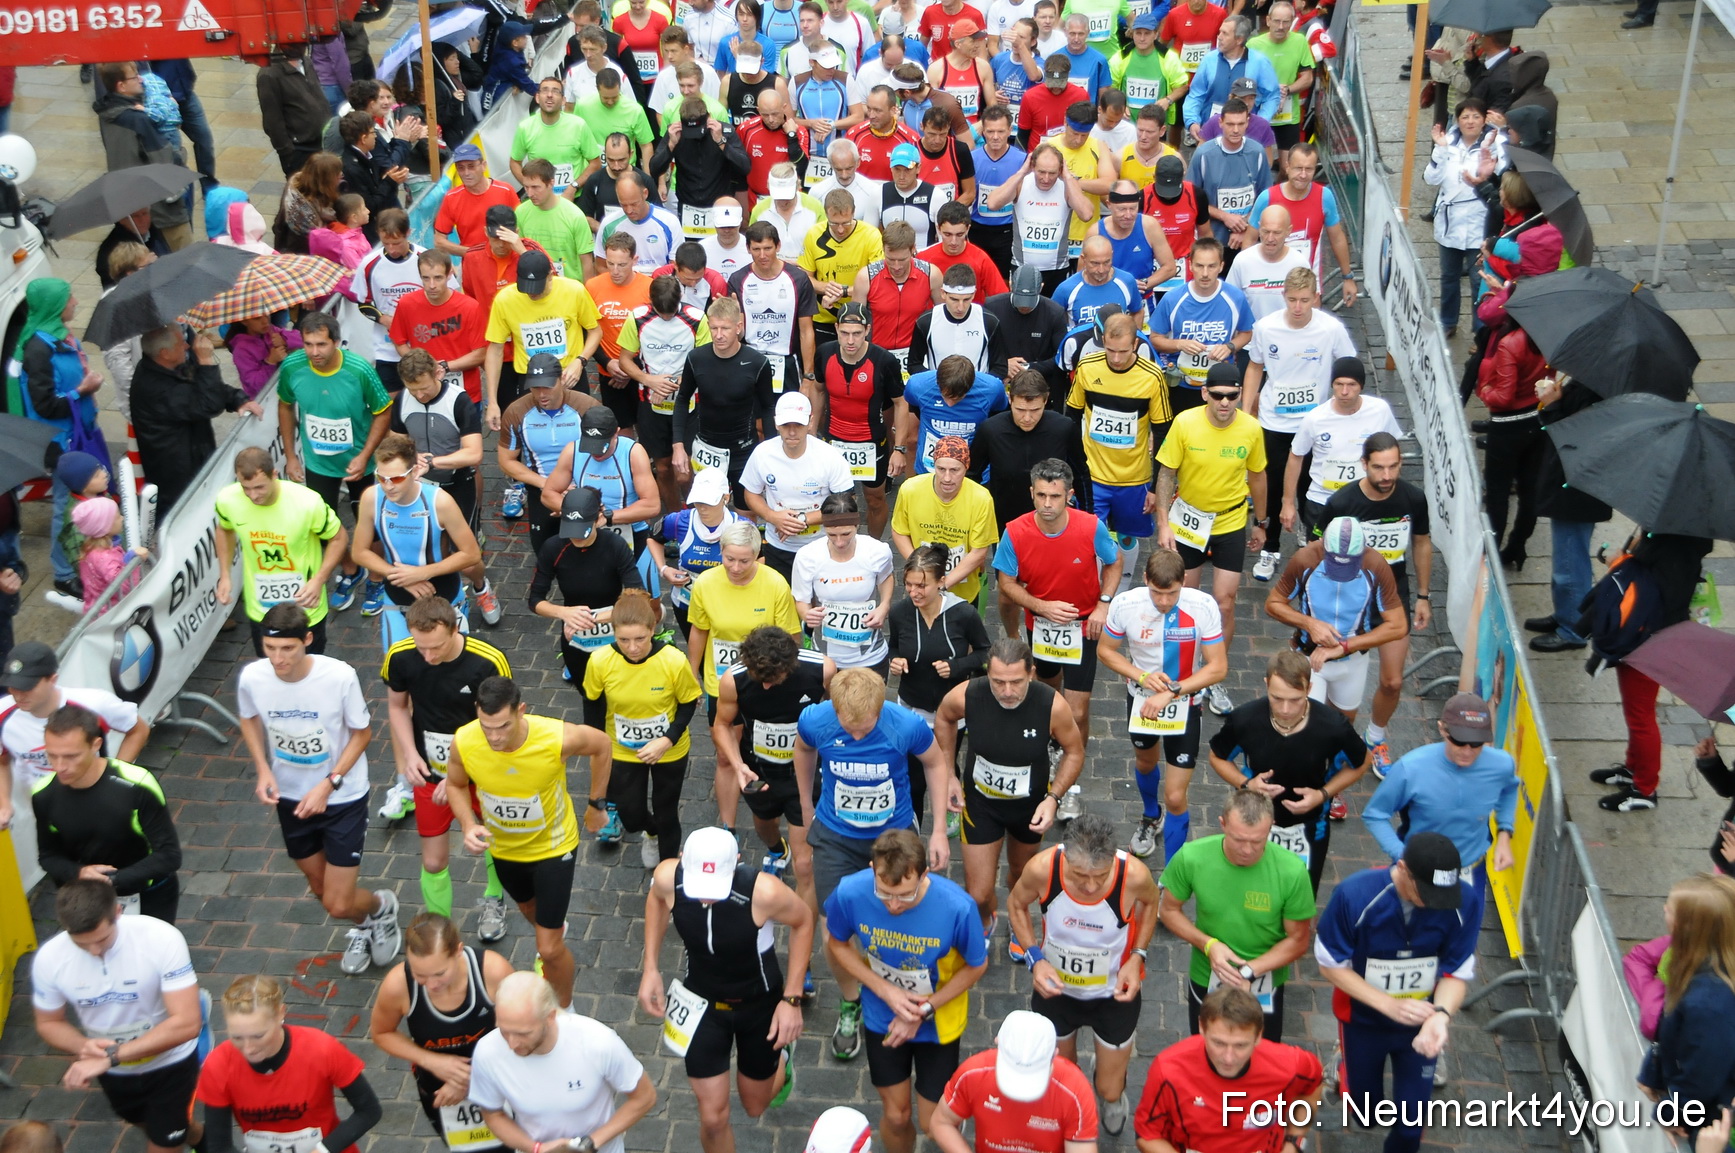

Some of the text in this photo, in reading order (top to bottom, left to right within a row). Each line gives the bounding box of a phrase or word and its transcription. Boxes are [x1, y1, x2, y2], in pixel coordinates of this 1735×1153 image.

[0, 4, 163, 35] 09181 6352
[637, 59, 656, 71] 989
[1129, 85, 1156, 98] 3114
[814, 164, 833, 177] 154
[1222, 194, 1251, 208] 2672
[693, 214, 706, 226] 81
[1026, 226, 1057, 240] 2697
[431, 314, 462, 338] RUN
[1182, 320, 1224, 332] Fitness
[526, 329, 563, 347] 2818
[1191, 354, 1209, 368] 90
[1278, 389, 1315, 405] 2035
[311, 425, 348, 441] 2483
[931, 419, 975, 432] HUBER
[1094, 417, 1131, 435] 2541
[1102, 436, 1122, 444] Tobias
[696, 449, 720, 468] 436
[1337, 465, 1355, 480] 73
[1182, 513, 1200, 530] 99
[250, 530, 287, 541] Müller
[1367, 533, 1399, 548] 325
[263, 549, 284, 562] M
[260, 583, 301, 599] 2532
[835, 632, 861, 641] Jessica
[1043, 628, 1071, 646] 375
[1044, 647, 1068, 656] Markus
[621, 724, 666, 740] 2933
[1141, 721, 1175, 730] Benjamin
[275, 735, 323, 754] 2433
[766, 733, 797, 748] 507
[829, 760, 889, 777] HUBER
[993, 767, 1020, 776] Neumarkt
[983, 771, 1017, 794] 344
[841, 793, 889, 810] 2773
[493, 805, 530, 819] 457
[853, 813, 879, 821] Simon
[859, 923, 940, 947] 10. NEUMARKTER
[870, 935, 925, 955] STADTLAUF
[1058, 954, 1095, 974] 161
[1063, 974, 1086, 985] Erich
[1381, 971, 1422, 990] 112
[469, 1129, 491, 1140] Anke
